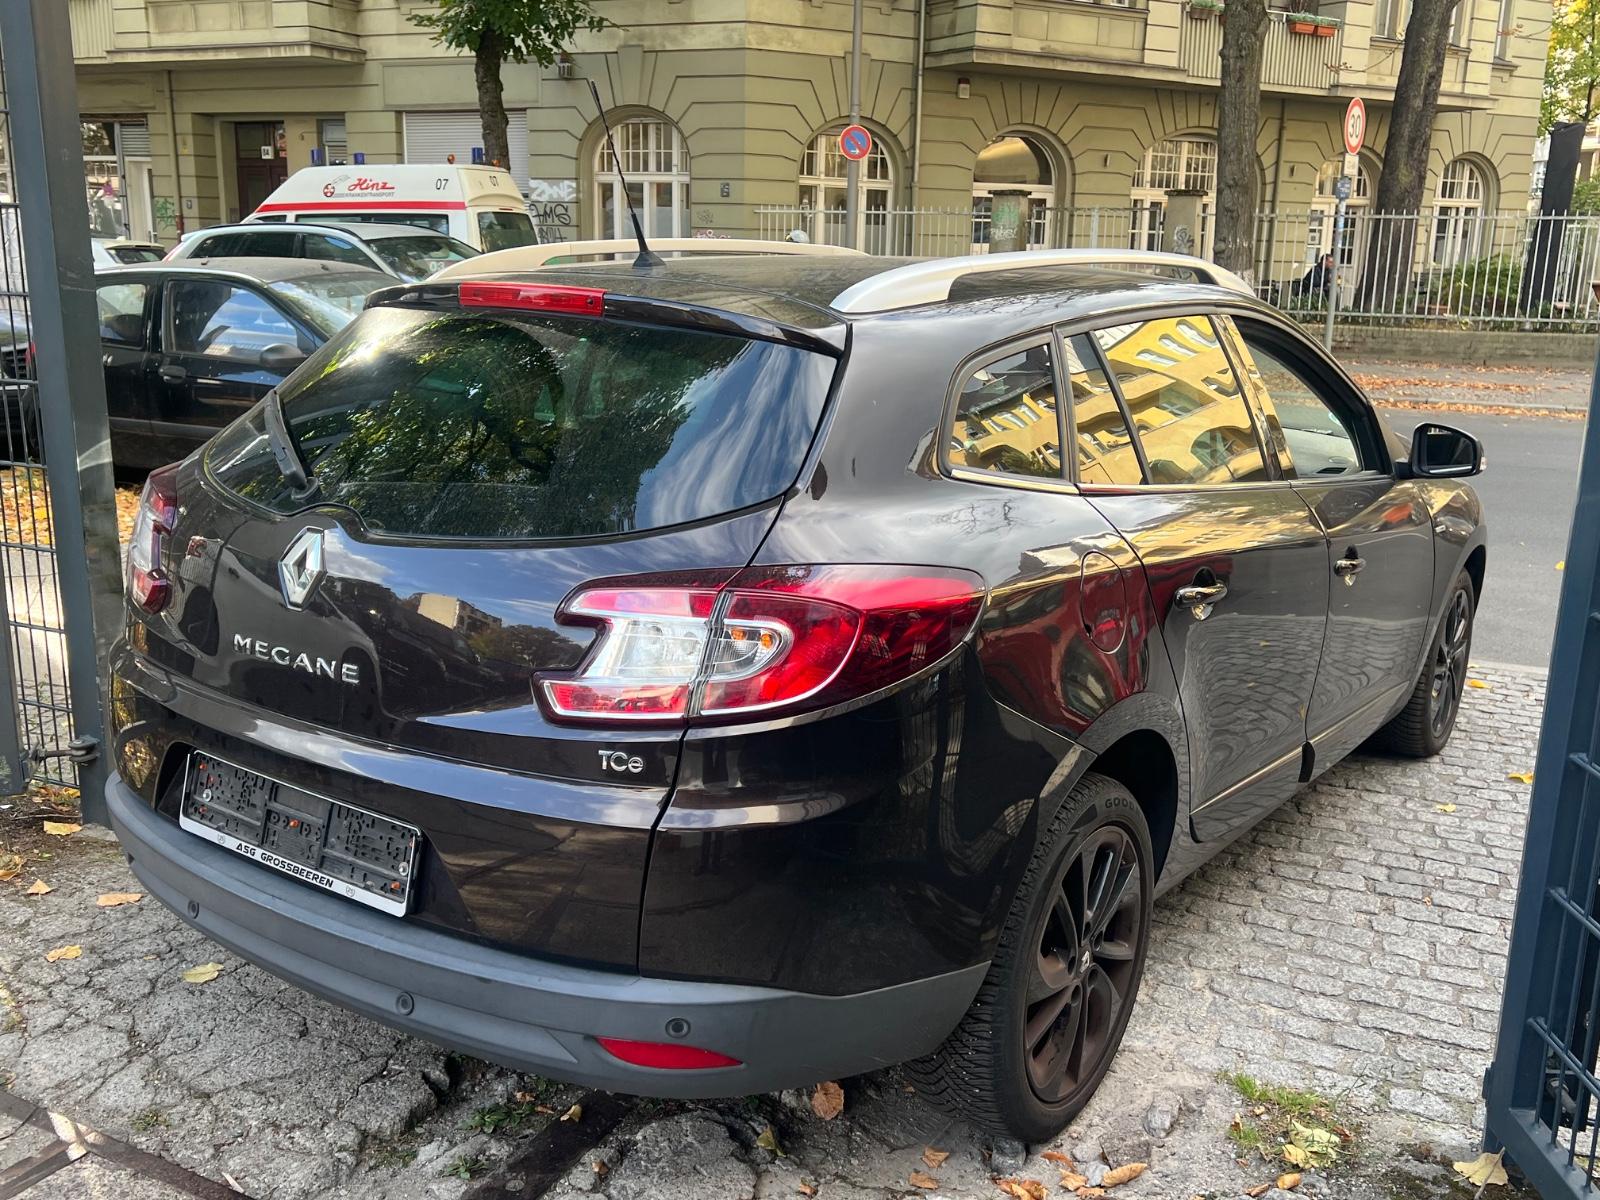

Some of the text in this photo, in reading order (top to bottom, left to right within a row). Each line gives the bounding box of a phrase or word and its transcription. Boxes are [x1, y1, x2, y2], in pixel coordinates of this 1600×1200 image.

[1349, 113, 1361, 138] 30
[347, 177, 395, 191] Hinz
[435, 178, 449, 190] 07
[233, 633, 360, 684] MEGANE
[598, 750, 643, 773] TCe
[235, 842, 334, 888] ASG GROSSBEEREN
